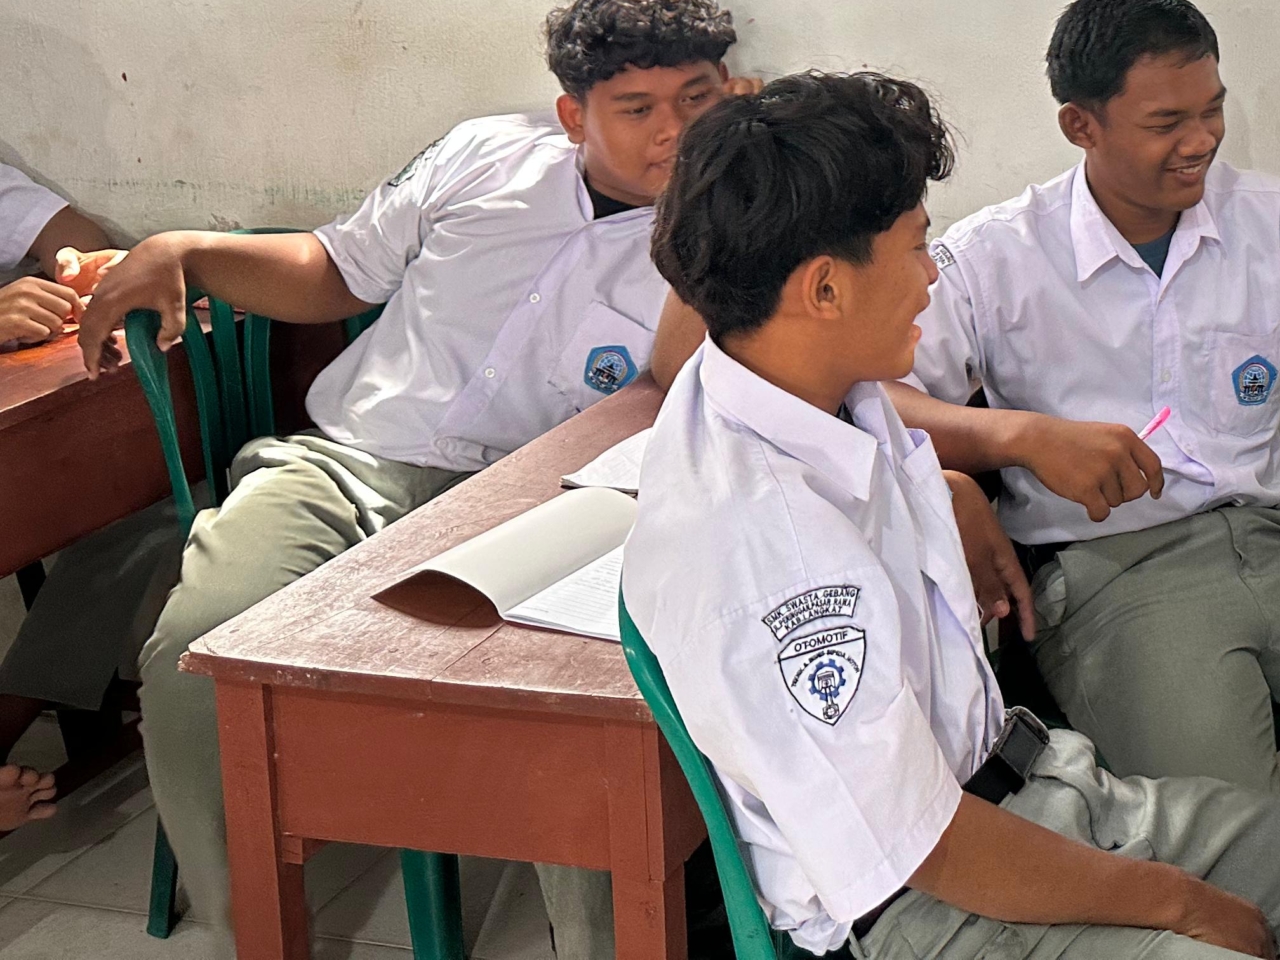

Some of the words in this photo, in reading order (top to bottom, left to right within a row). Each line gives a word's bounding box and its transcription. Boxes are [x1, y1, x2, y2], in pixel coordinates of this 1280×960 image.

[786, 593, 819, 612] SWASTA
[823, 588, 856, 598] GEBANG
[794, 630, 848, 652] OTOMOTIF
